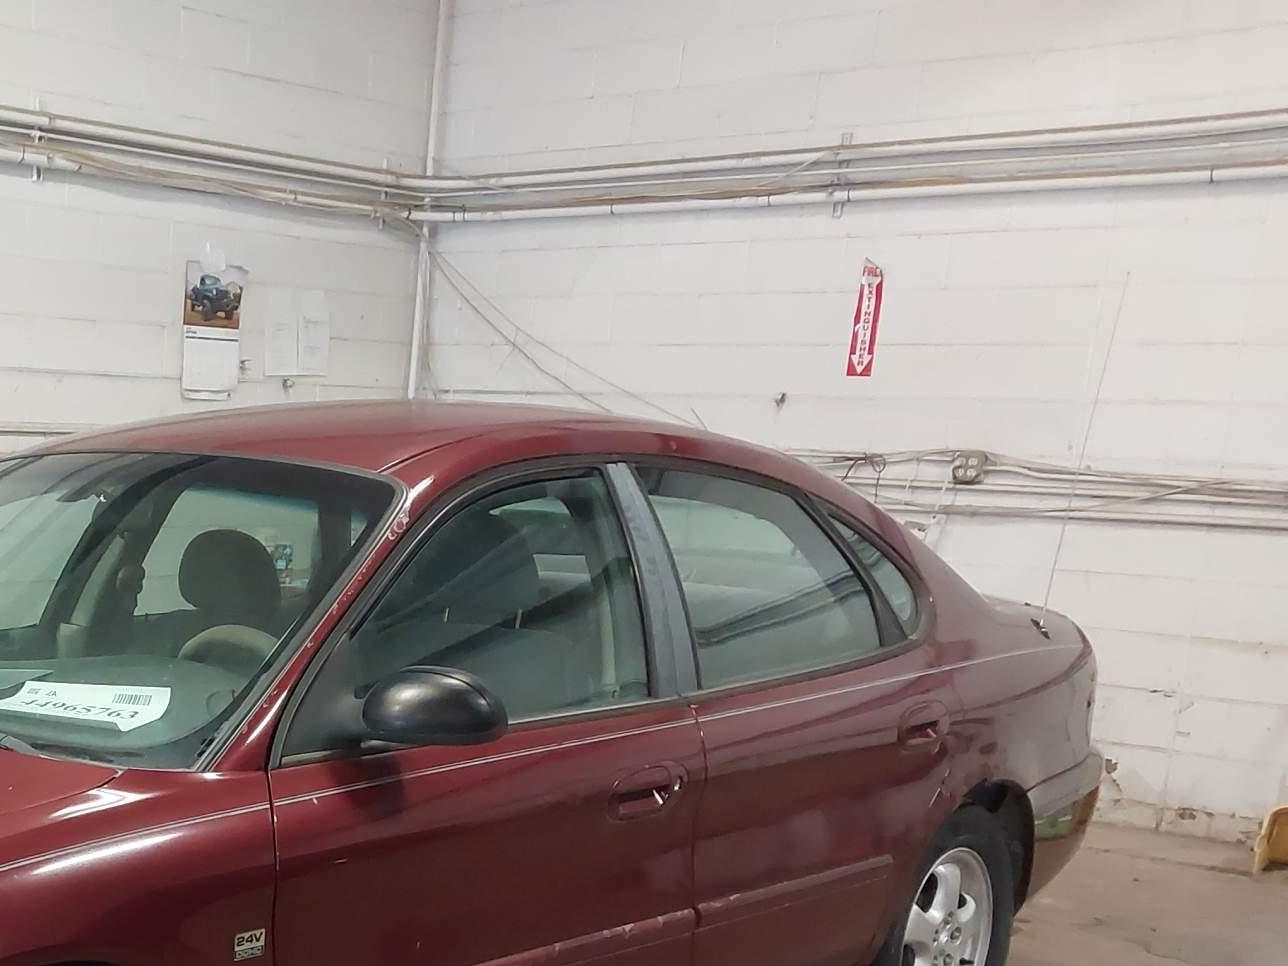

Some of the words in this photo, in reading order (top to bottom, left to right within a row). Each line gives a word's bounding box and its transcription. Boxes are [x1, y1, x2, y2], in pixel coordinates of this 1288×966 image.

[857, 282, 874, 366] EXTINGUISHER
[20, 699, 140, 719] 44965763
[236, 931, 264, 947] 24V
